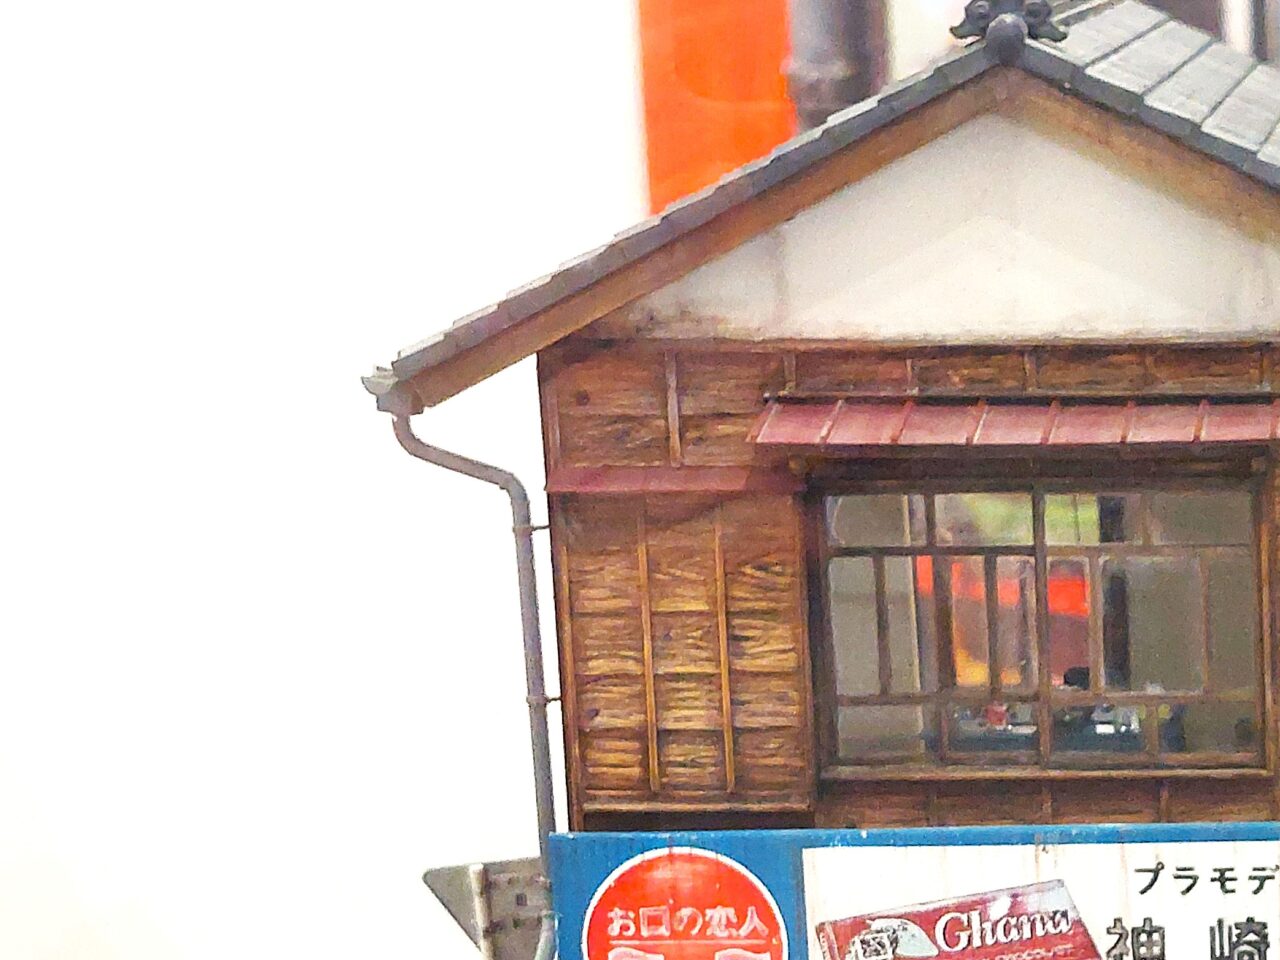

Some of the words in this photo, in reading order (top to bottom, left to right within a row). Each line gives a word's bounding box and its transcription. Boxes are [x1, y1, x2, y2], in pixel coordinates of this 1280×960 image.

[607, 905, 769, 938] お口の恋人
[934, 908, 1073, 952] Ghana
